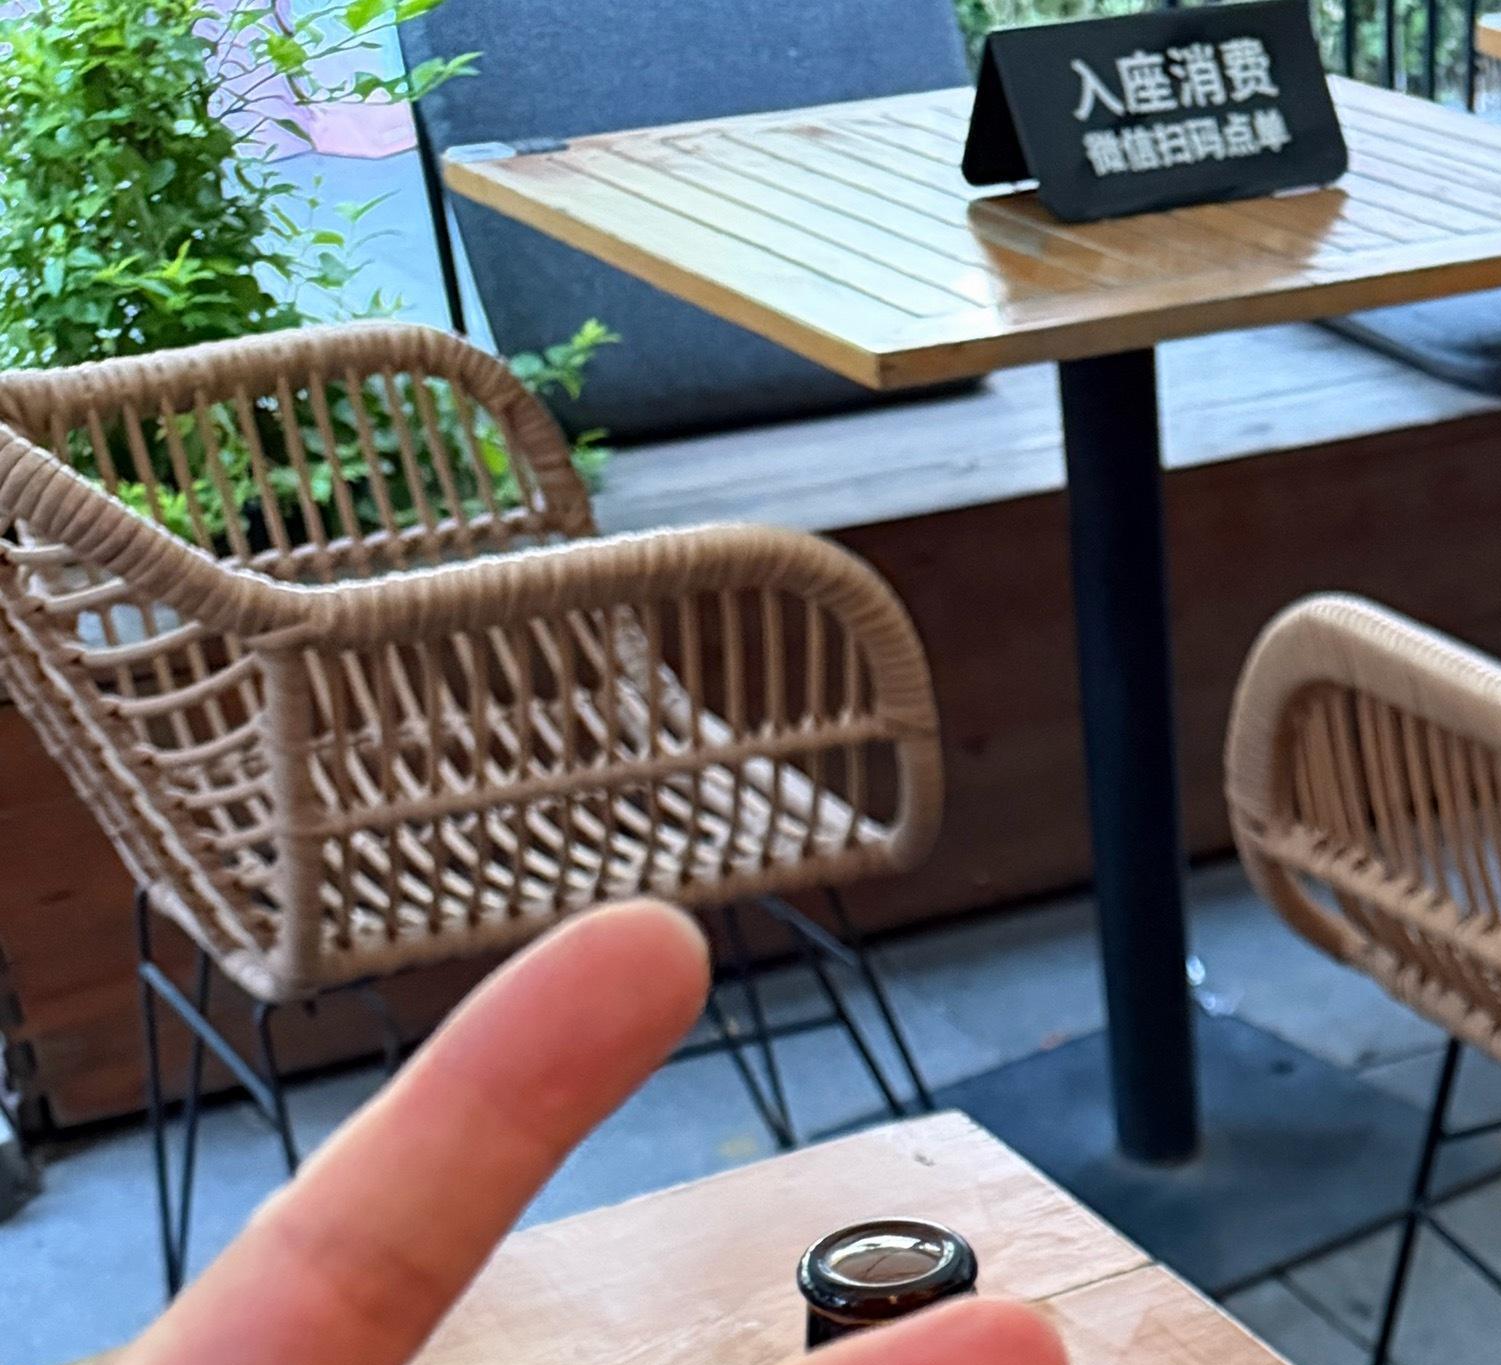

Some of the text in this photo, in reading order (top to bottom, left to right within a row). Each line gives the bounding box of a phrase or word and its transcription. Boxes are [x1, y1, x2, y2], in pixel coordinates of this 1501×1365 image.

[1070, 37, 1279, 121] 入座消费
[1082, 109, 1293, 176] 微信扫码点单
